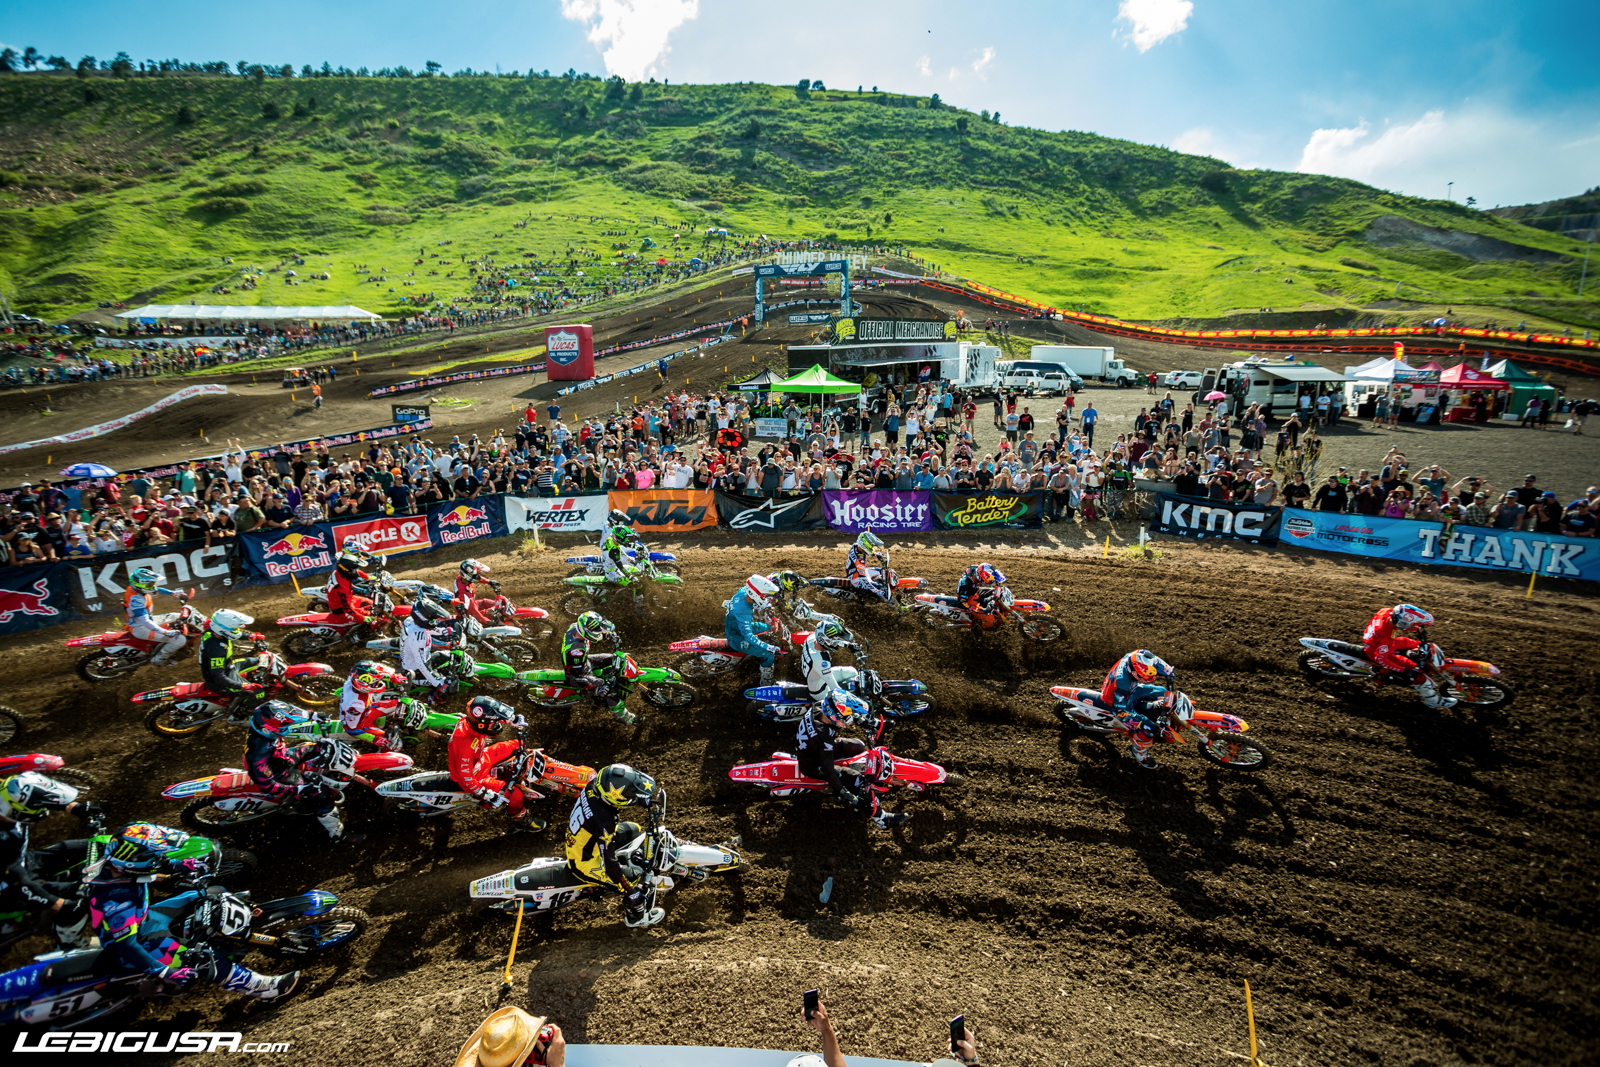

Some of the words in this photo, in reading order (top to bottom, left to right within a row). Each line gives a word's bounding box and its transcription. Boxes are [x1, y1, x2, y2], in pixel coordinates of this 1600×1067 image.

[859, 321, 894, 340] OFFICIAL
[895, 322, 944, 340] MERCHANDISE
[552, 341, 576, 350] LUCAS
[831, 497, 928, 526] Hoosier
[967, 495, 1019, 512] Battery
[526, 509, 590, 523] VERTEX
[624, 500, 708, 526] KTM
[953, 509, 1009, 527] Tender
[344, 528, 397, 545] CIRCLE
[440, 530, 466, 544] Red
[466, 522, 492, 538] Bull
[1317, 533, 1389, 546] MOTOCROSS
[1418, 528, 1585, 576] THANK
[265, 556, 300, 577] Red
[299, 551, 332, 571] Bull
[211, 658, 225, 667] FLY
[553, 688, 563, 699] 1
[185, 701, 208, 713] 41
[784, 707, 802, 715] 103
[233, 800, 263, 811] 101
[433, 795, 452, 805] 19
[549, 890, 574, 908] 16
[48, 995, 85, 1018] 51
